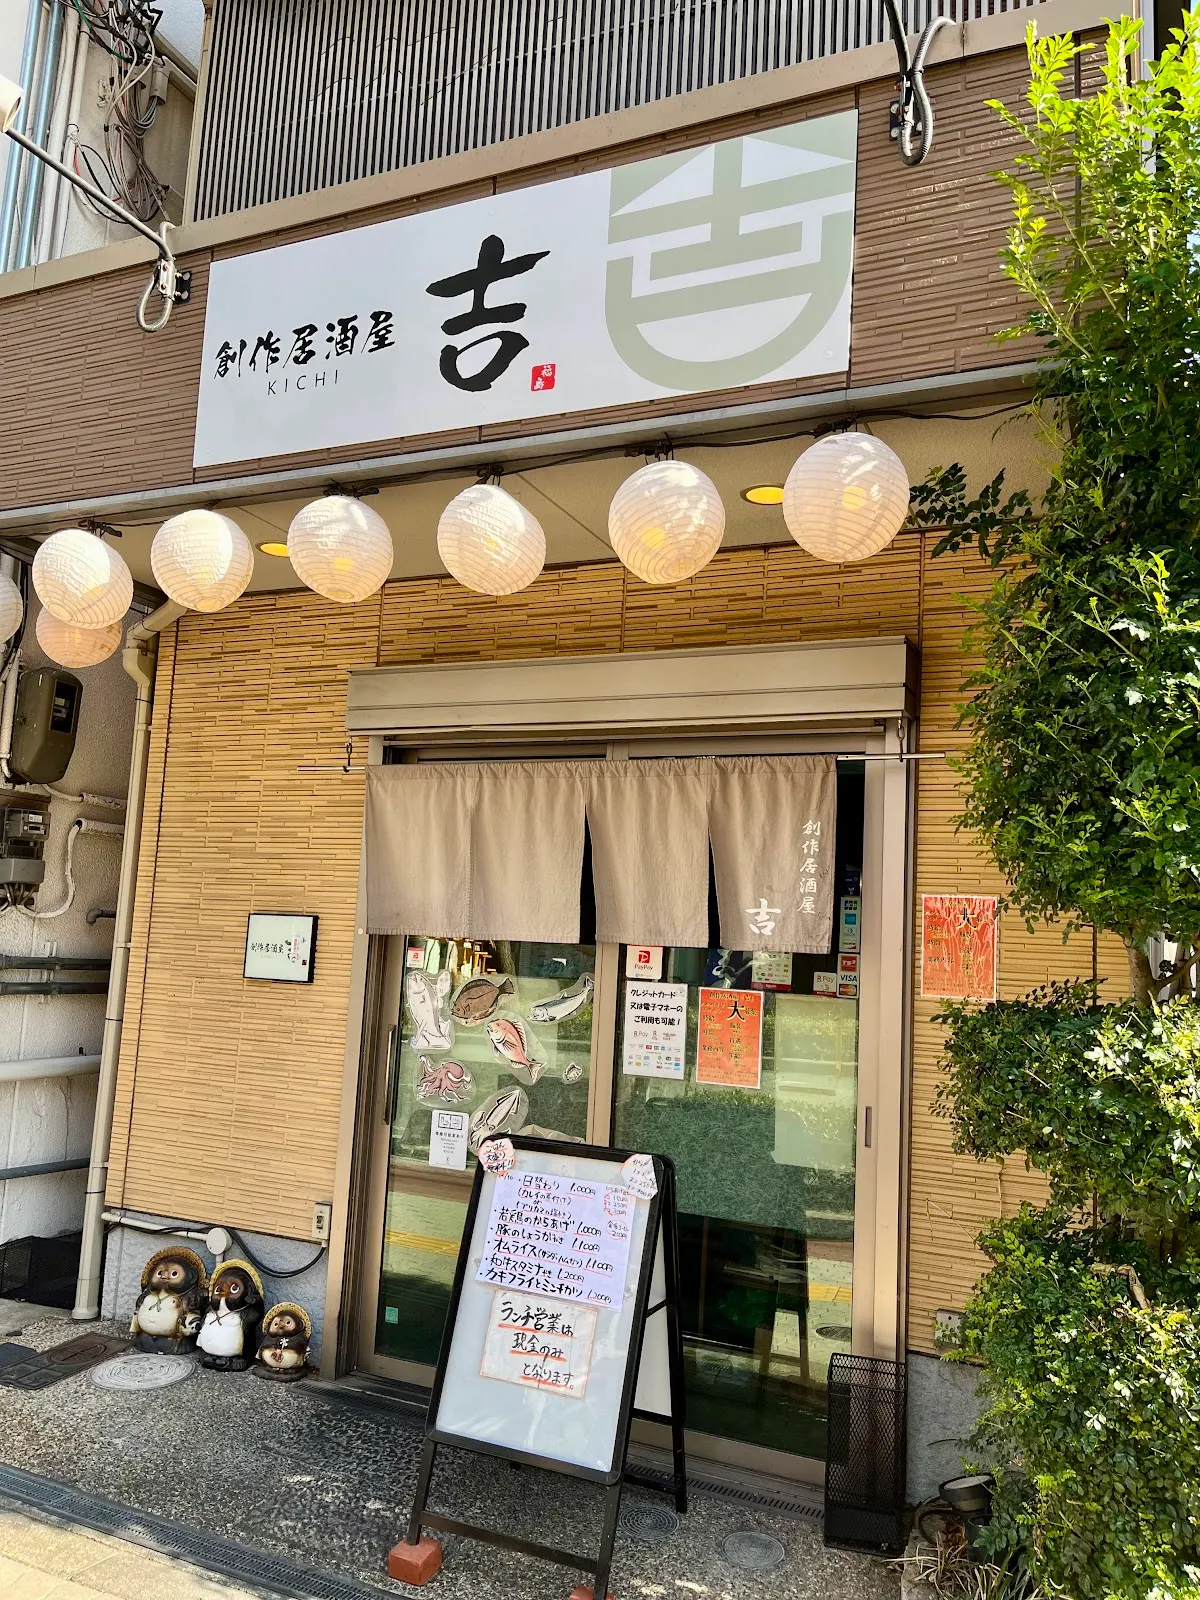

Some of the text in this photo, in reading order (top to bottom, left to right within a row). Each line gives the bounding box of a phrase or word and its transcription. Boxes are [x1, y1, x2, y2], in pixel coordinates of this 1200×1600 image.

[426, 234, 551, 392] 吉
[214, 310, 396, 379] 創作居酒屋
[267, 369, 339, 396] KICHI
[797, 819, 822, 915] 創作居酒屋
[745, 898, 782, 936] 吉
[634, 963, 653, 971] PayPay
[840, 974, 858, 983] VISA
[630, 988, 677, 1000] クレジットカード
[630, 1002, 684, 1014] 又は電子マネーの
[728, 1000, 746, 1021] 大
[501, 1301, 574, 1337] ランチ営業は
[511, 1332, 564, 1364] 現金のみ
